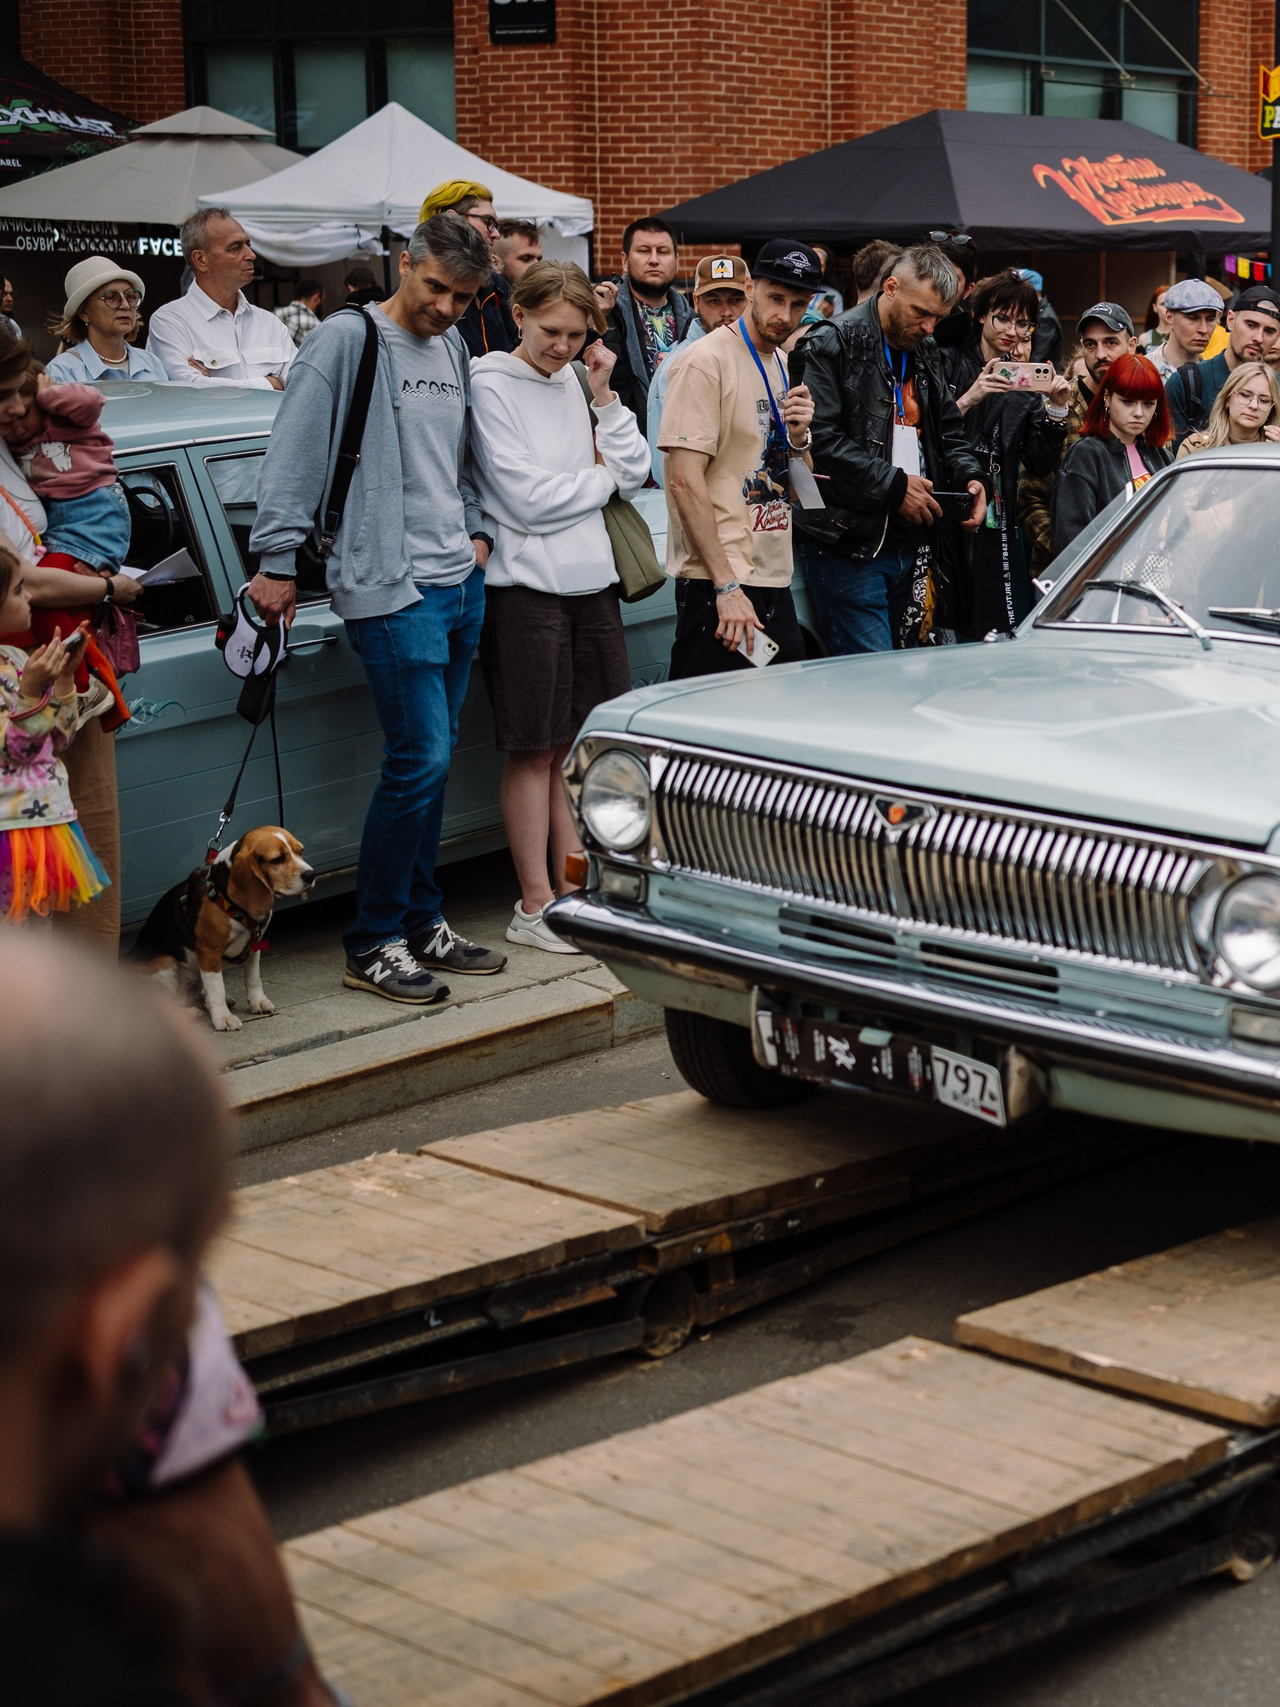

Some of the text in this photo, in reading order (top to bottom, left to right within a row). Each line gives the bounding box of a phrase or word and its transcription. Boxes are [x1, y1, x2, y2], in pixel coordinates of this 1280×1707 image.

[16, 236, 138, 253] ОБУВИ КРОССОВКИ
[1004, 582, 1013, 609] FUTURE
[934, 1056, 988, 1101] 797
